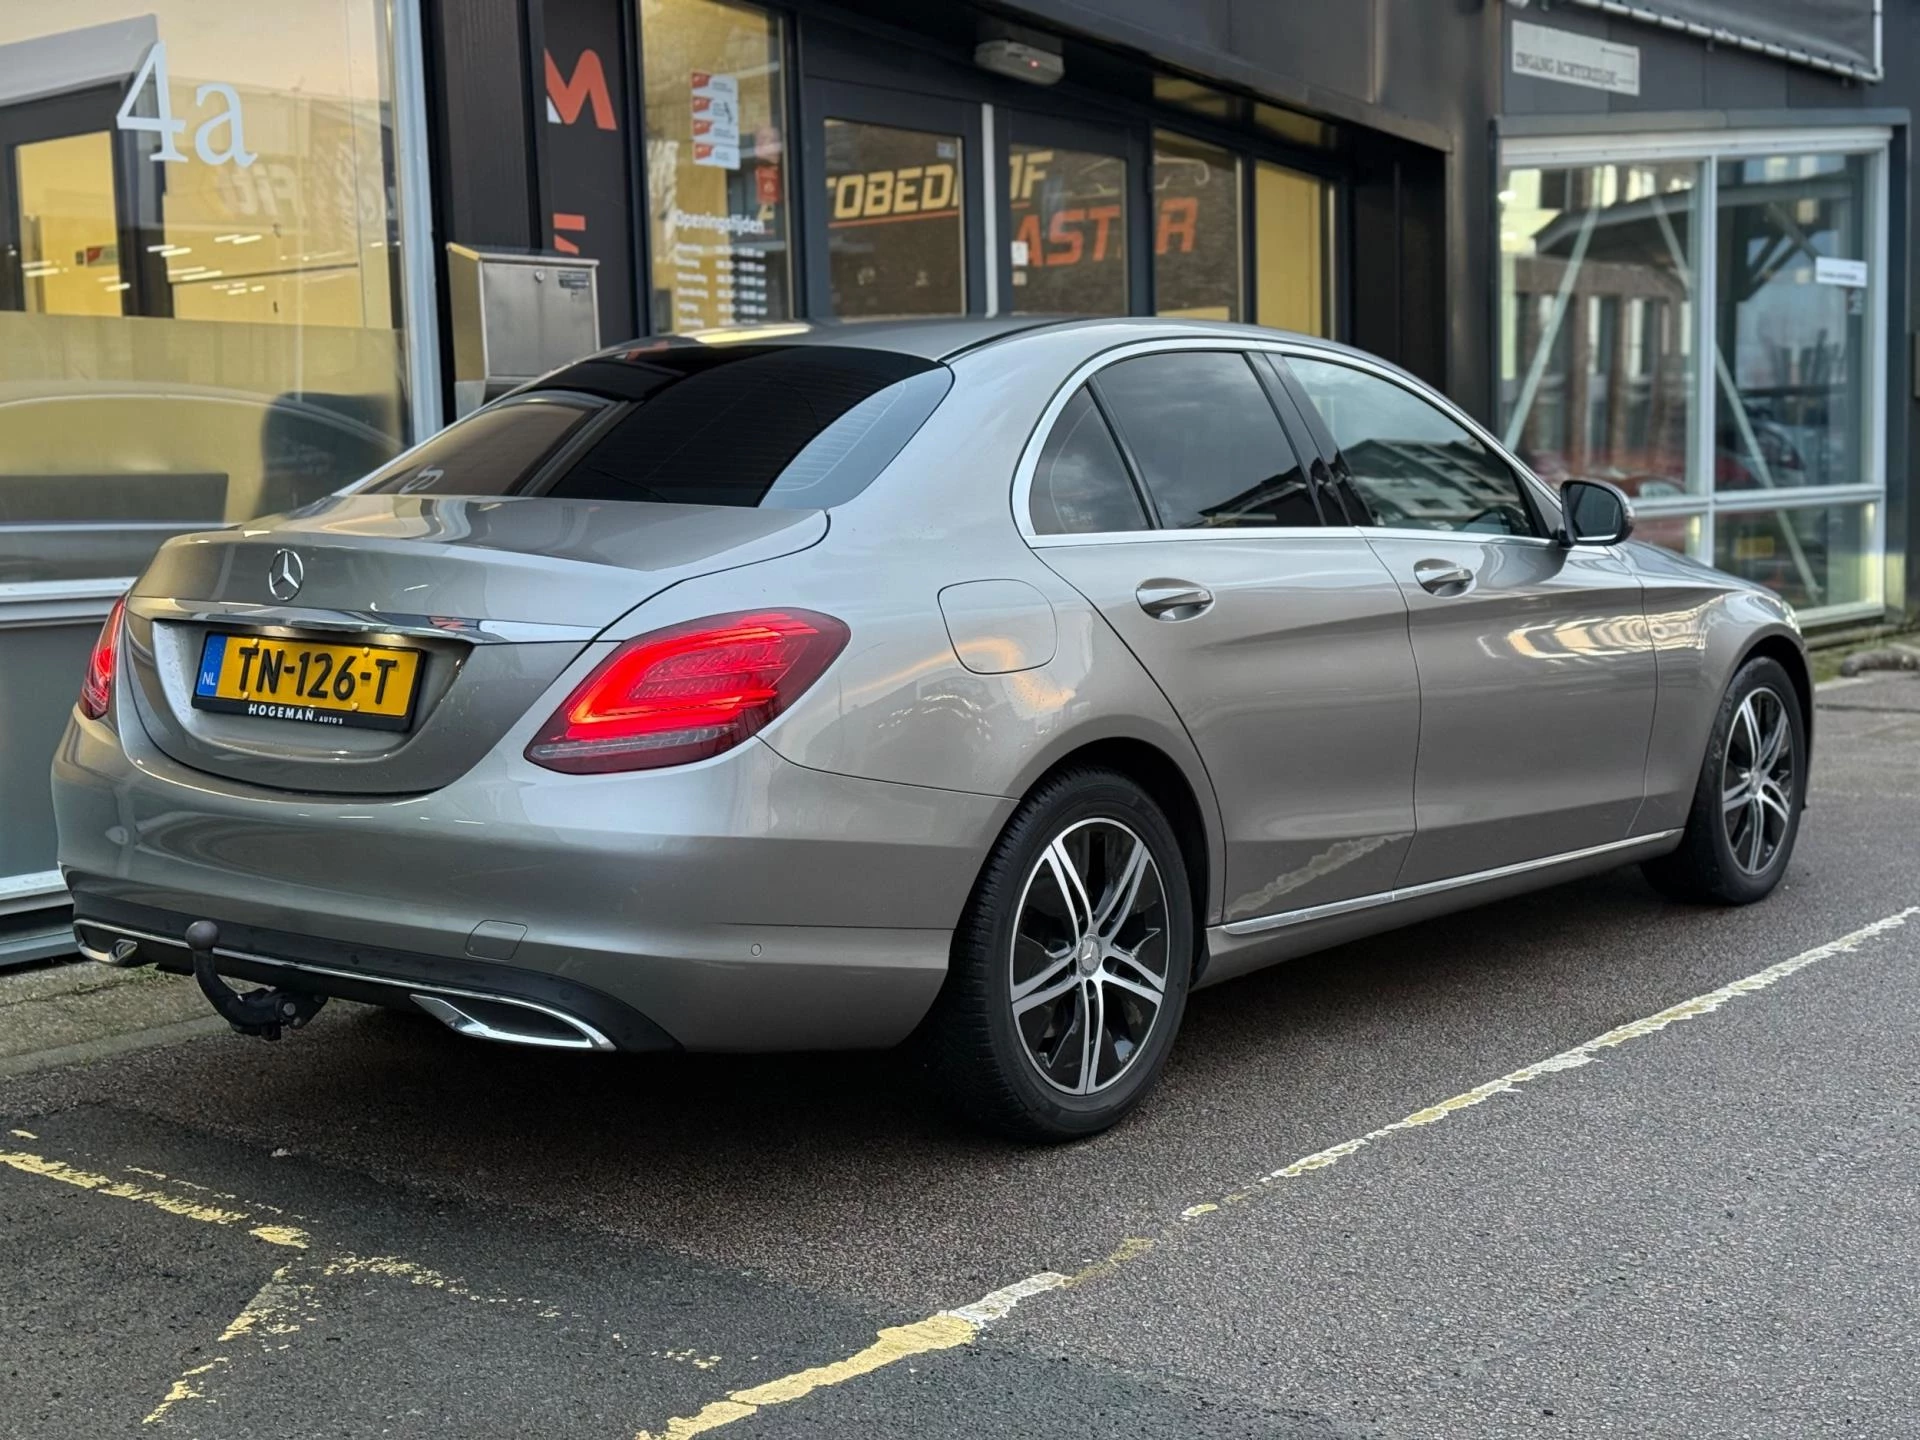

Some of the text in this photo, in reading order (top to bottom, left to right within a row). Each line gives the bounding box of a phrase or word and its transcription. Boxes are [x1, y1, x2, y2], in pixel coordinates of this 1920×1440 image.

[116, 40, 258, 167] 4a
[201, 671, 216, 686] NL
[238, 646, 398, 705] TN-126-T
